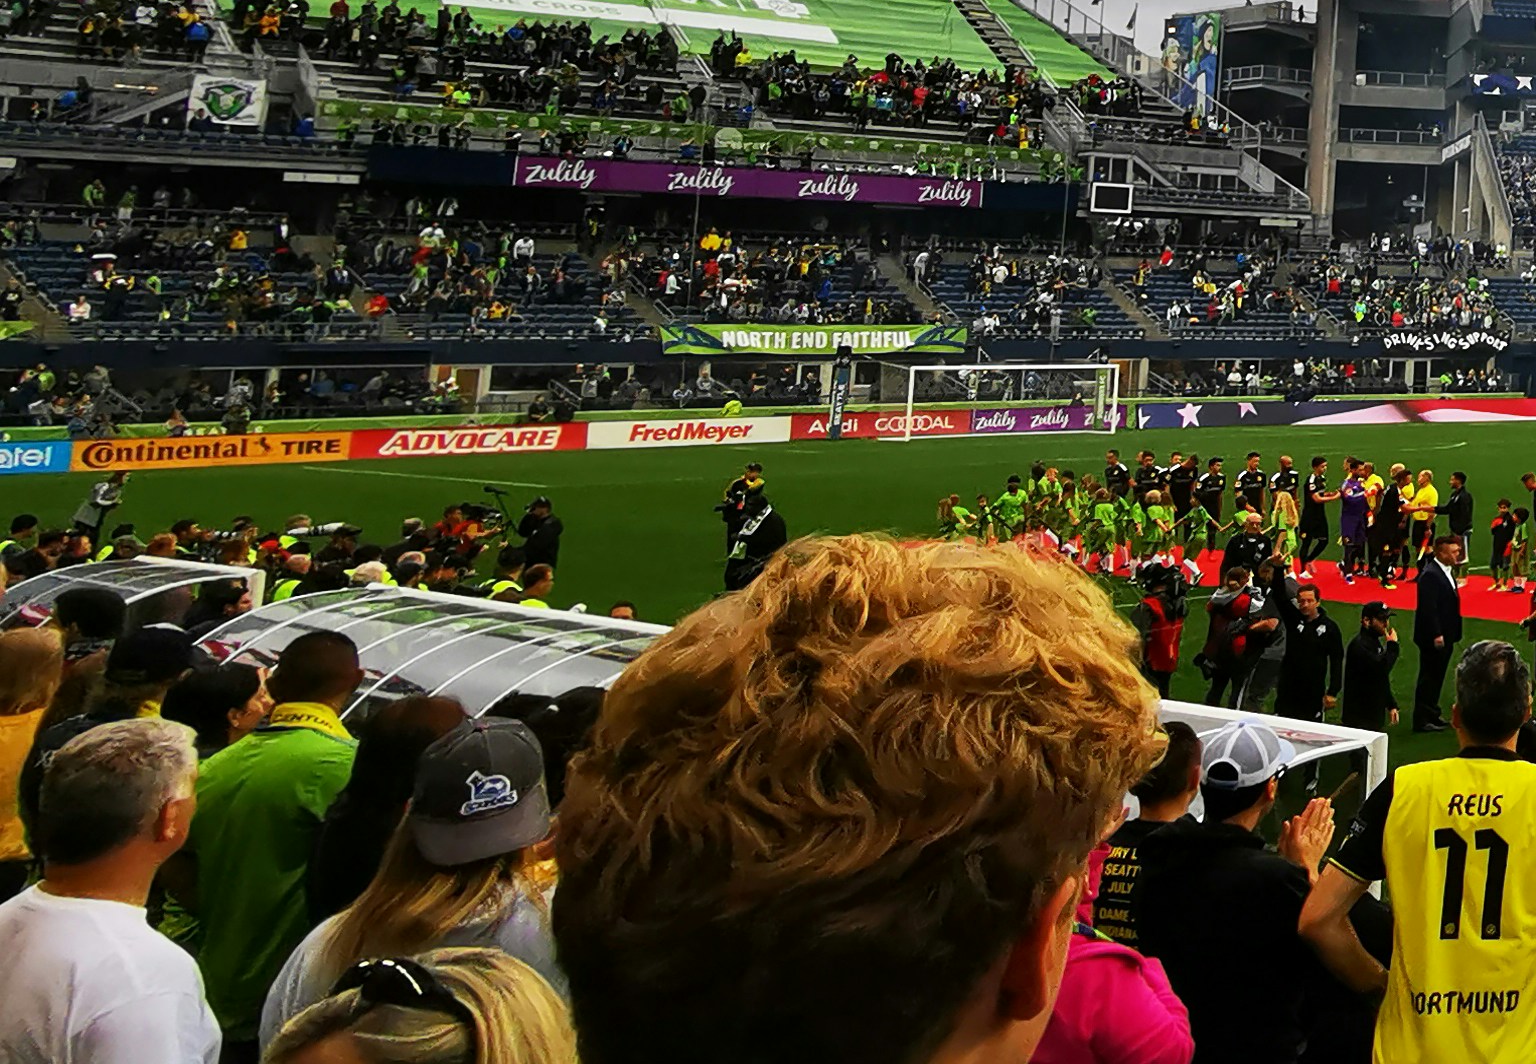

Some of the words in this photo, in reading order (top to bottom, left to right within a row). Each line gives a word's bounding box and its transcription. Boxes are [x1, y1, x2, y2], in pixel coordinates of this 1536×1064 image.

[721, 330, 788, 349] NORTH
[791, 330, 828, 349] END
[831, 329, 915, 349] FAITHFUL
[808, 416, 858, 433] Adi
[379, 425, 562, 455] ADVOCARE
[81, 438, 249, 469] Continental
[280, 438, 342, 456] TIRE
[1447, 793, 1504, 817] REUS
[1107, 881, 1135, 894] JULY
[1433, 827, 1509, 940] 11
